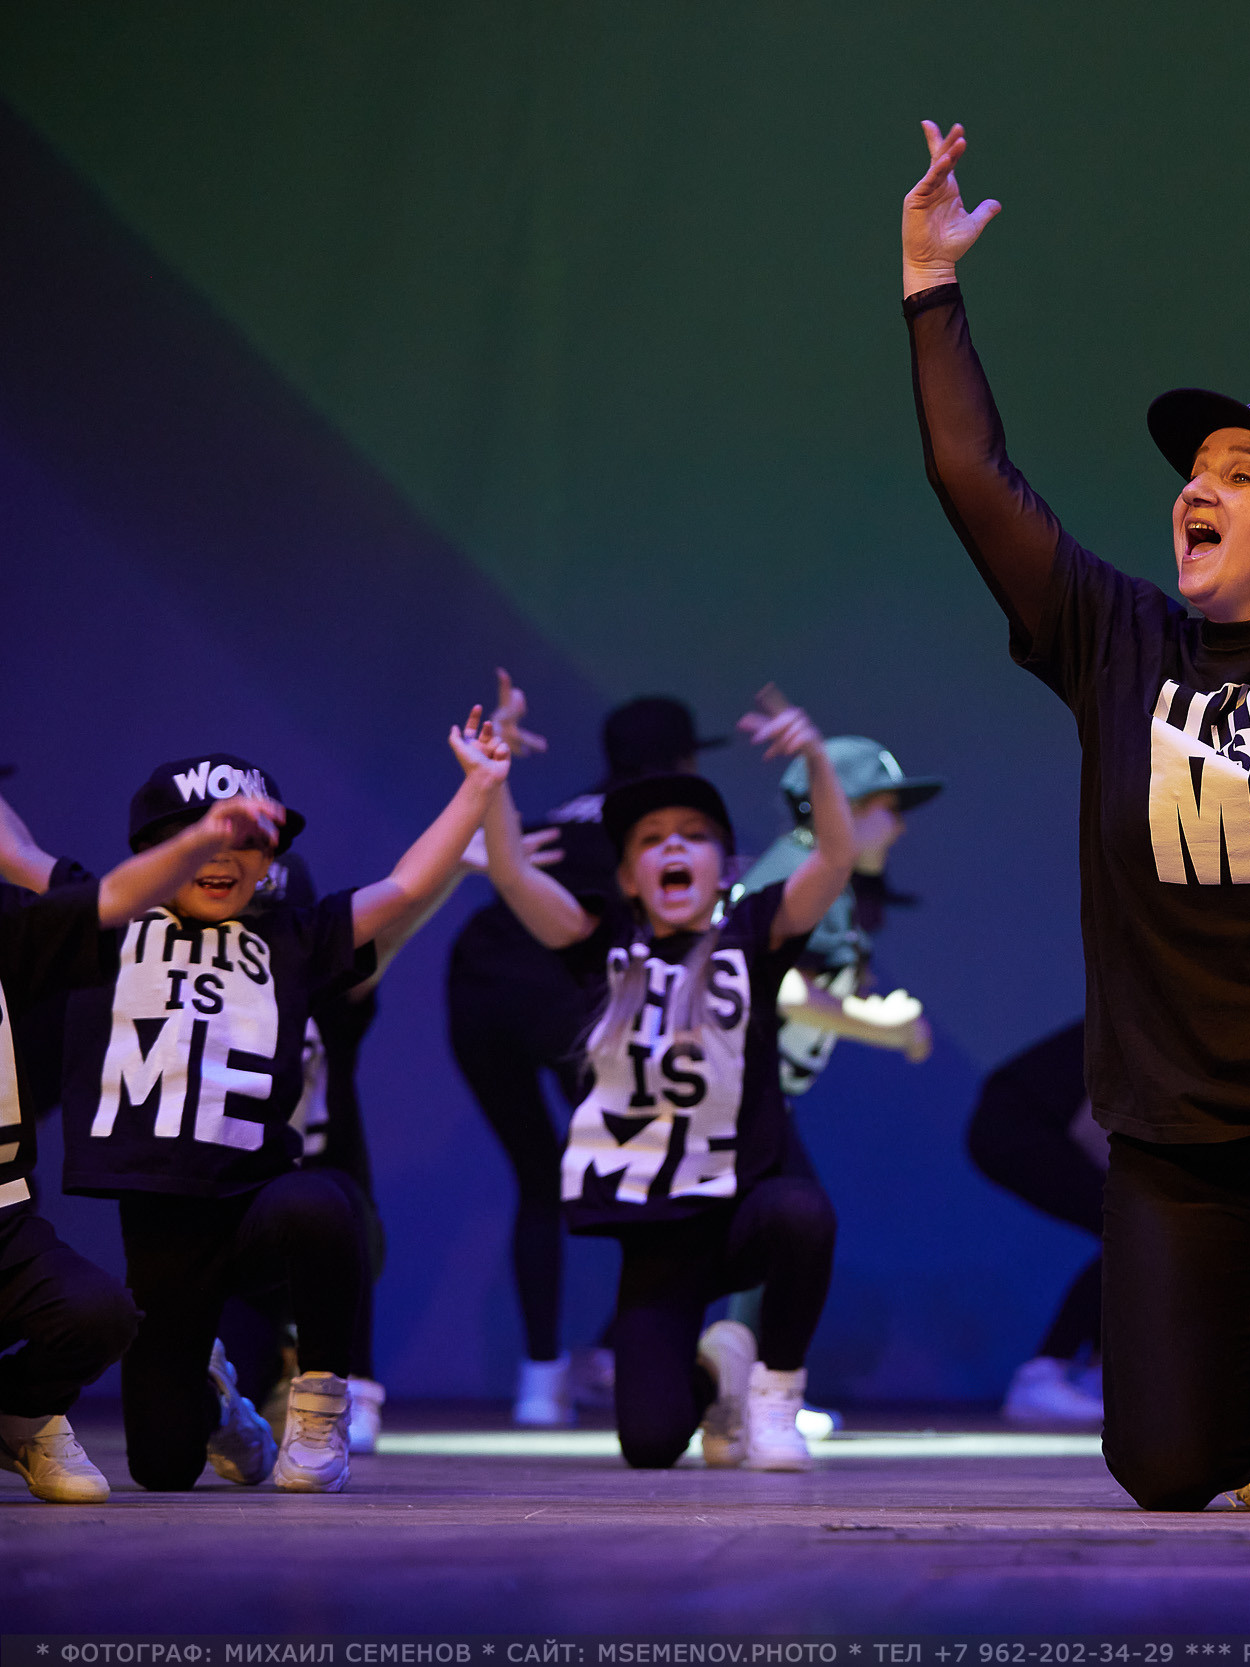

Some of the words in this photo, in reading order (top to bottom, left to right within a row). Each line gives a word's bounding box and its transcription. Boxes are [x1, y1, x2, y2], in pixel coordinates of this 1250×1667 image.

[135, 911, 270, 986] THIS
[165, 968, 225, 1015] IS
[89, 1016, 278, 1152] ME
[628, 1042, 707, 1108] IS
[560, 1110, 739, 1206] ME
